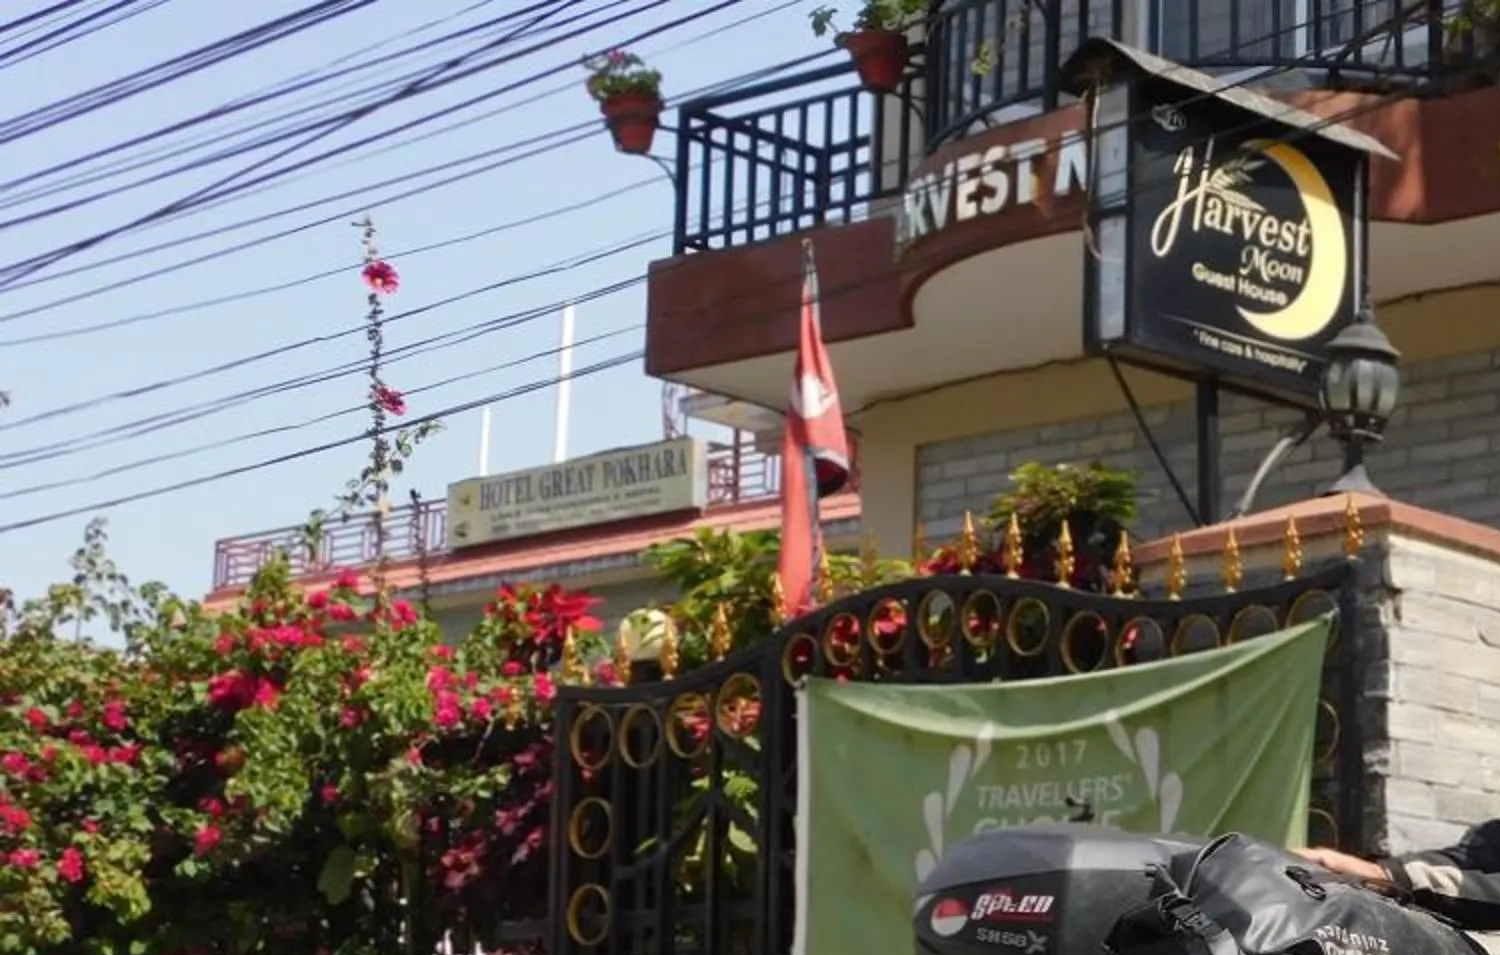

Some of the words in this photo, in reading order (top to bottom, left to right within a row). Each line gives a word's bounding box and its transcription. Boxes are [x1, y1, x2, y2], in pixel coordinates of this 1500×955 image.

[1151, 134, 1313, 258] Harvest
[1192, 261, 1236, 293] Guest
[1238, 278, 1288, 306] House
[1239, 246, 1304, 283] Moon
[480, 475, 534, 511] HOTEL
[539, 463, 595, 500] GREAT
[602, 448, 688, 490] POKHARA
[1016, 740, 1088, 769] 2017
